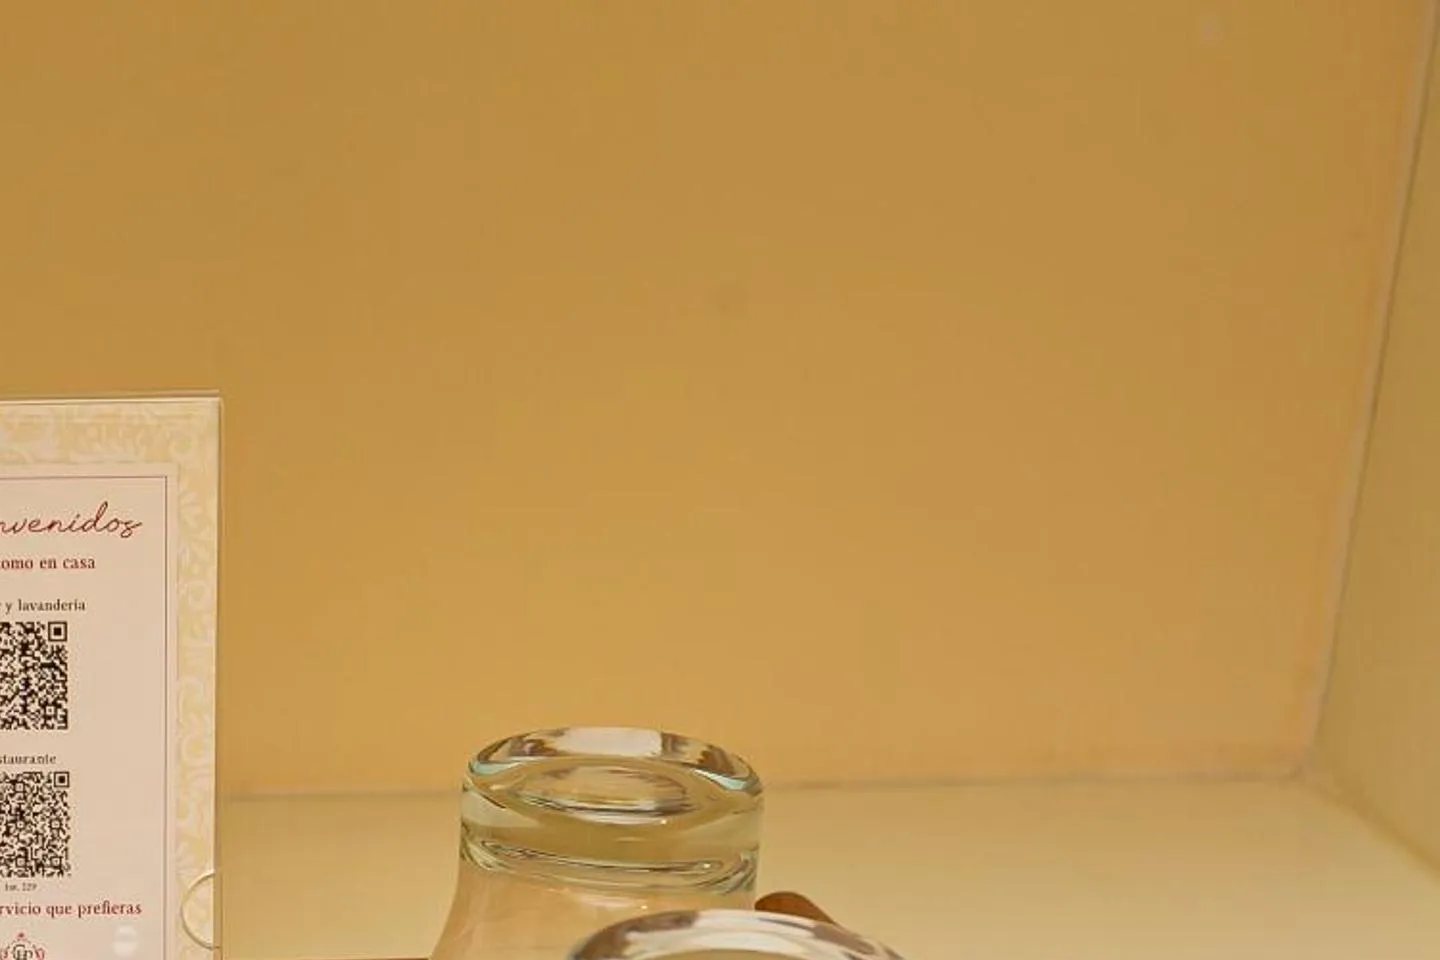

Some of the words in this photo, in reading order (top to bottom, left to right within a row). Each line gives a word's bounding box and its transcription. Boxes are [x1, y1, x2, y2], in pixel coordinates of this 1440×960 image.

[39, 557, 58, 570] en
[62, 557, 96, 570] casa
[5, 602, 12, 615] y
[46, 904, 72, 918] que
[78, 901, 142, 918] prefieras
